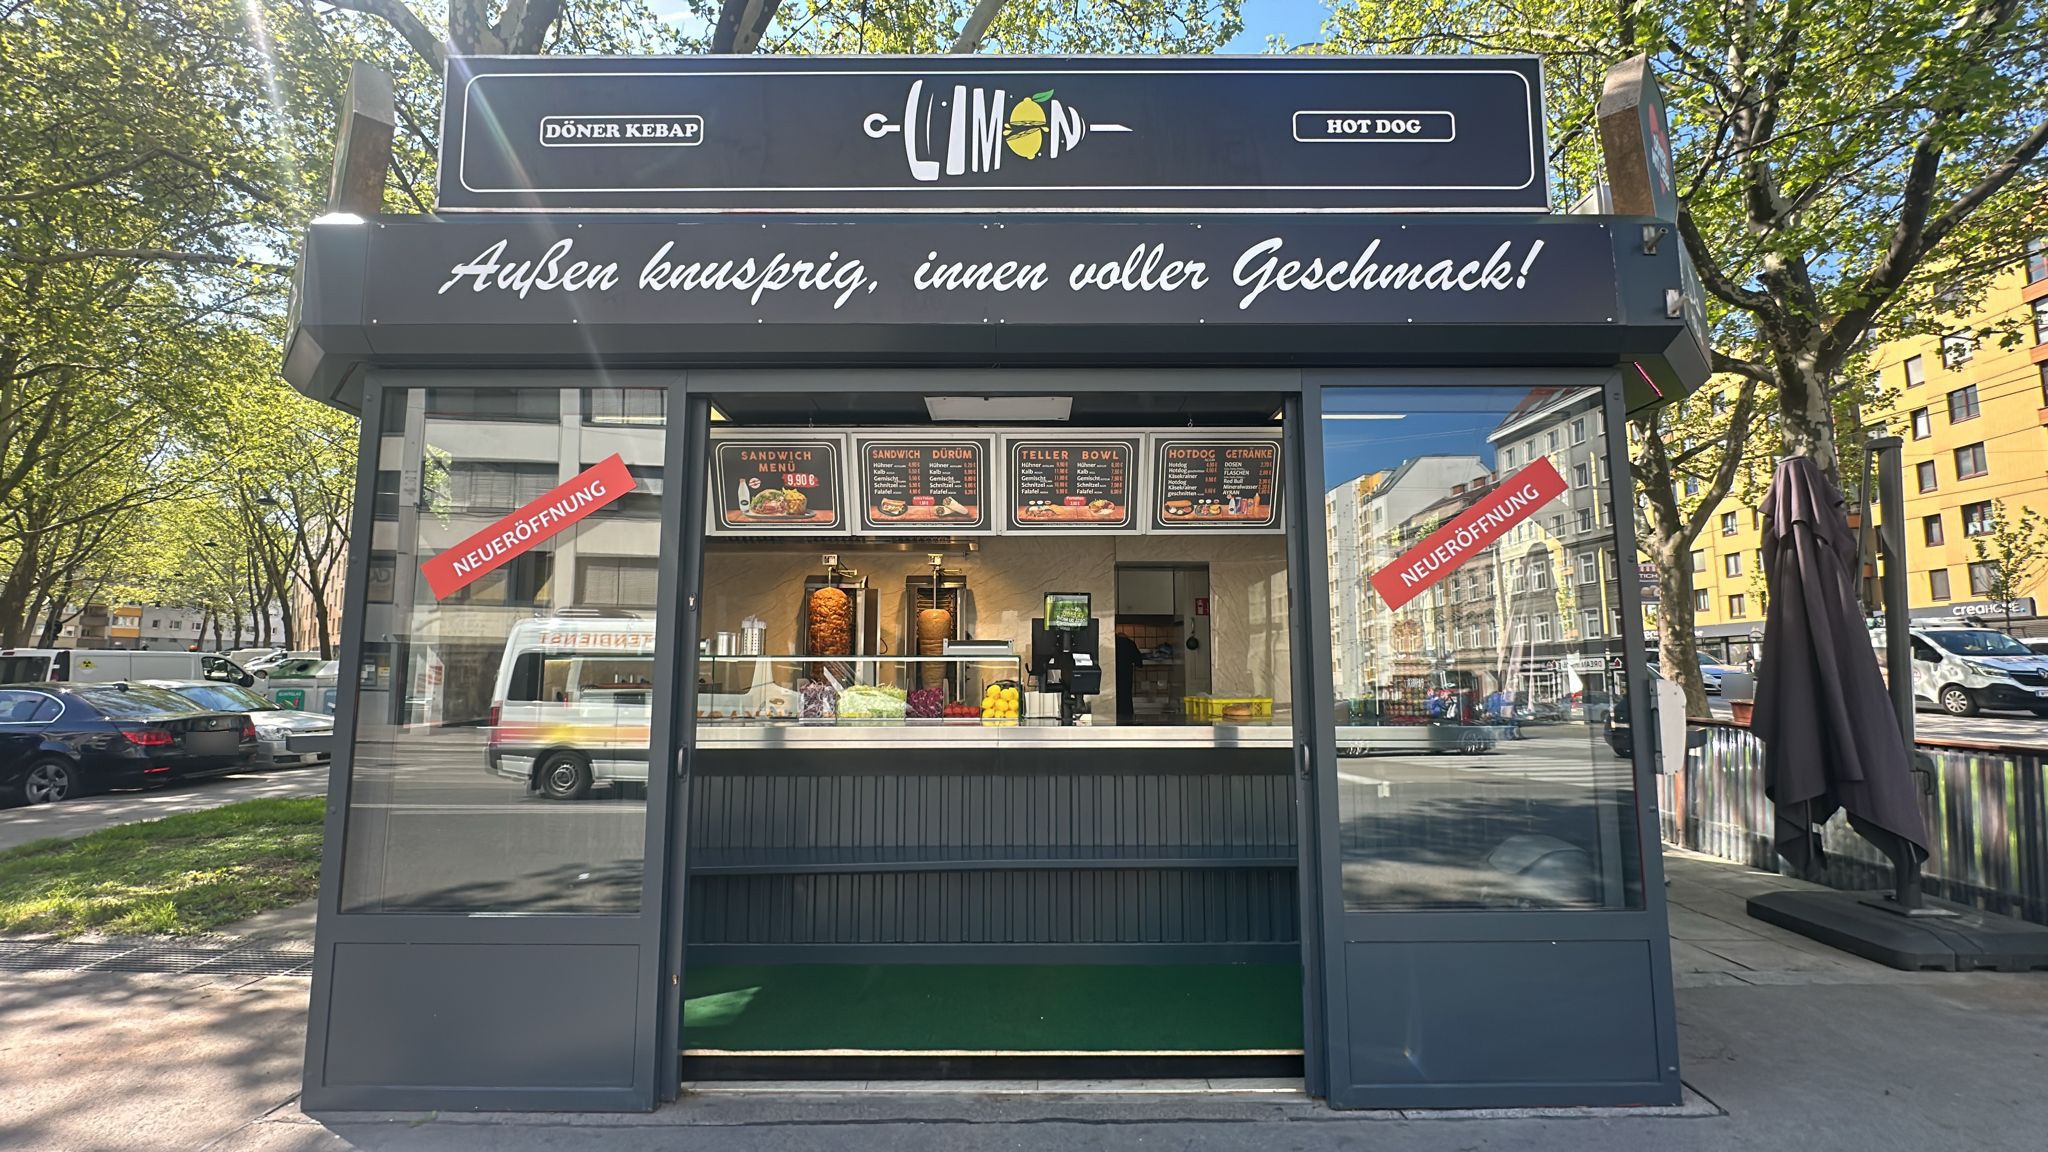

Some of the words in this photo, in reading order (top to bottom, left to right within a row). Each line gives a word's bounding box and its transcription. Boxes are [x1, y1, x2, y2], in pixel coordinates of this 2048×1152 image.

[545, 119, 621, 140] DÖNER
[625, 120, 699, 139] KEBAP
[1326, 118, 1371, 134] HOT
[1375, 118, 1422, 134] DOG
[437, 237, 619, 300] Außen
[638, 240, 879, 310] knusprig,
[912, 249, 1049, 292] innen
[1068, 242, 1209, 292] voller
[1231, 237, 1546, 310] Geschmack!
[741, 450, 812, 460] SANDWICH
[872, 449, 921, 459] SANDWICH
[932, 448, 973, 459] DÜRÜM
[1022, 450, 1069, 460] TELLER
[1082, 450, 1119, 460] BOWL
[1168, 449, 1216, 459] HOTDOG
[1226, 448, 1273, 459] GETRÄNKE
[758, 461, 796, 472] MENÜ
[787, 474, 806, 487] 9,90
[452, 479, 607, 577] NEUERÖFFNUNG
[1400, 483, 1540, 588] NEUERÖFFNUNG
[1952, 601, 2020, 616] creaHOE
